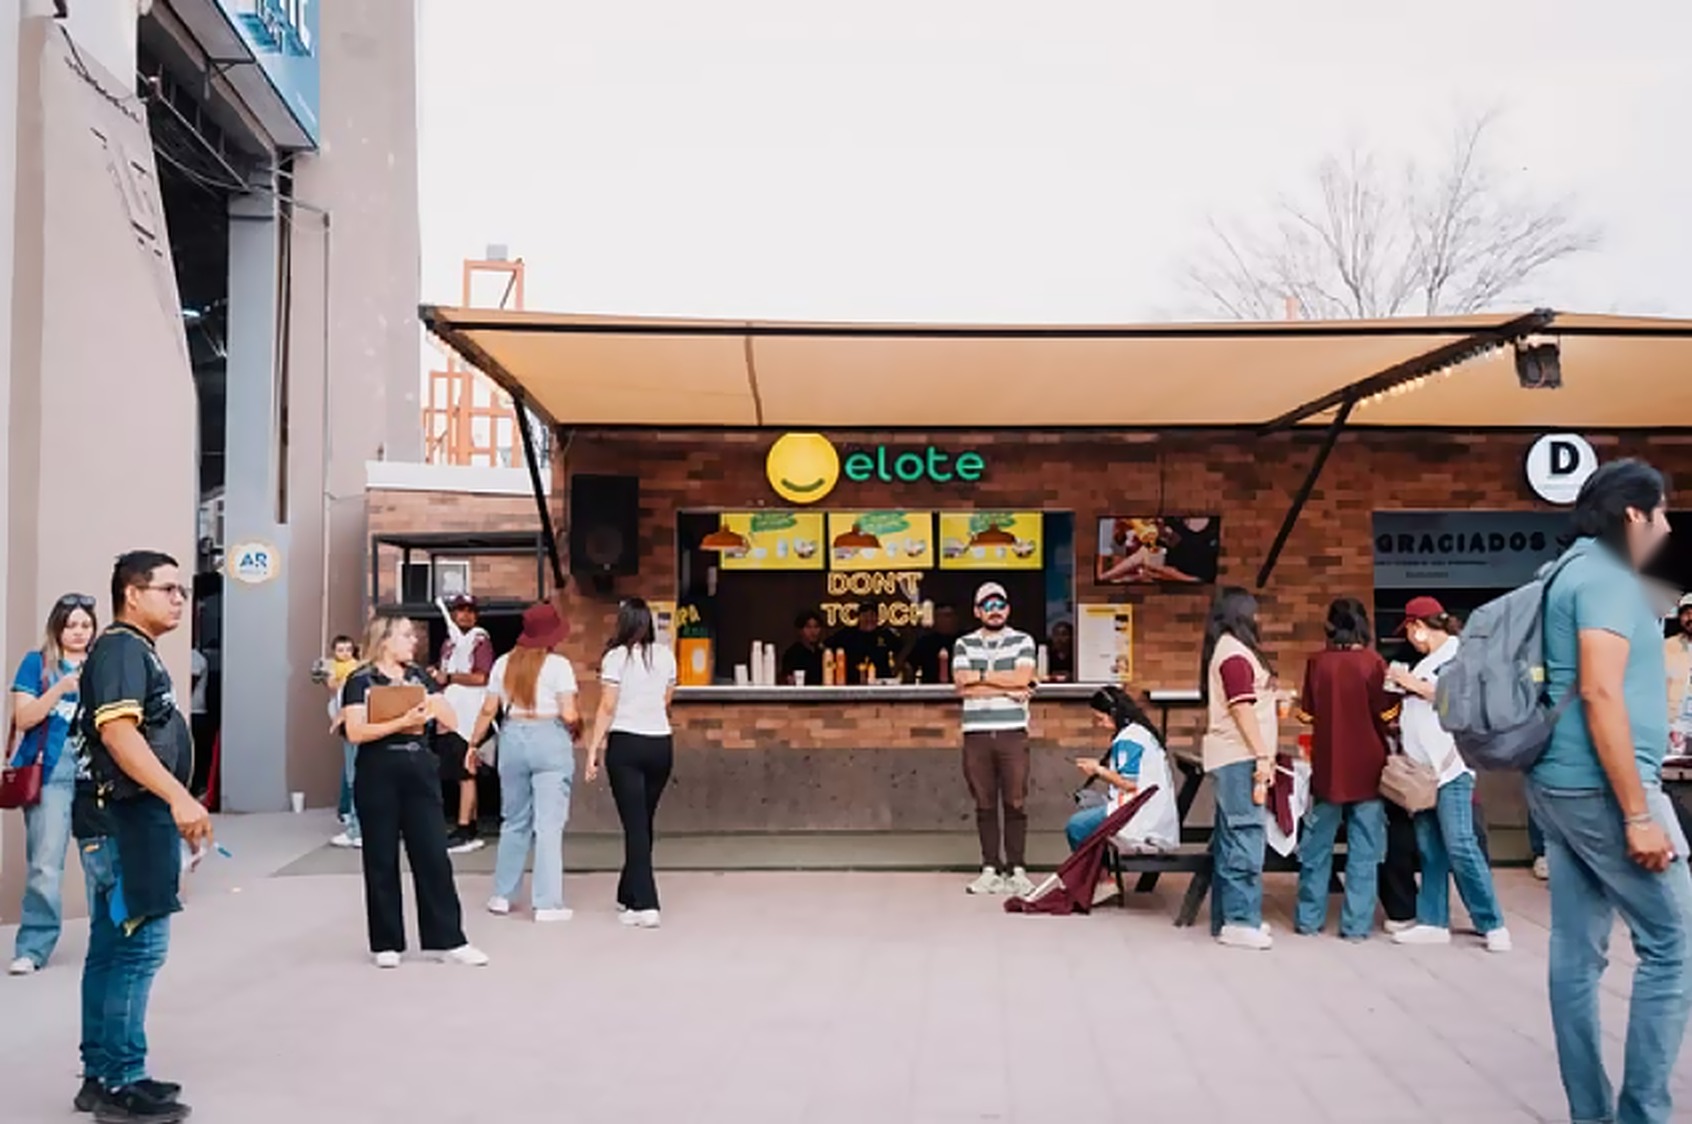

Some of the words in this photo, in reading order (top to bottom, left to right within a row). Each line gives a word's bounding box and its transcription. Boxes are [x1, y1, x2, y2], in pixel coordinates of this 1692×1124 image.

[844, 445, 985, 482] elote
[1550, 441, 1580, 475] D
[1376, 532, 1547, 554] GRACIADOS
